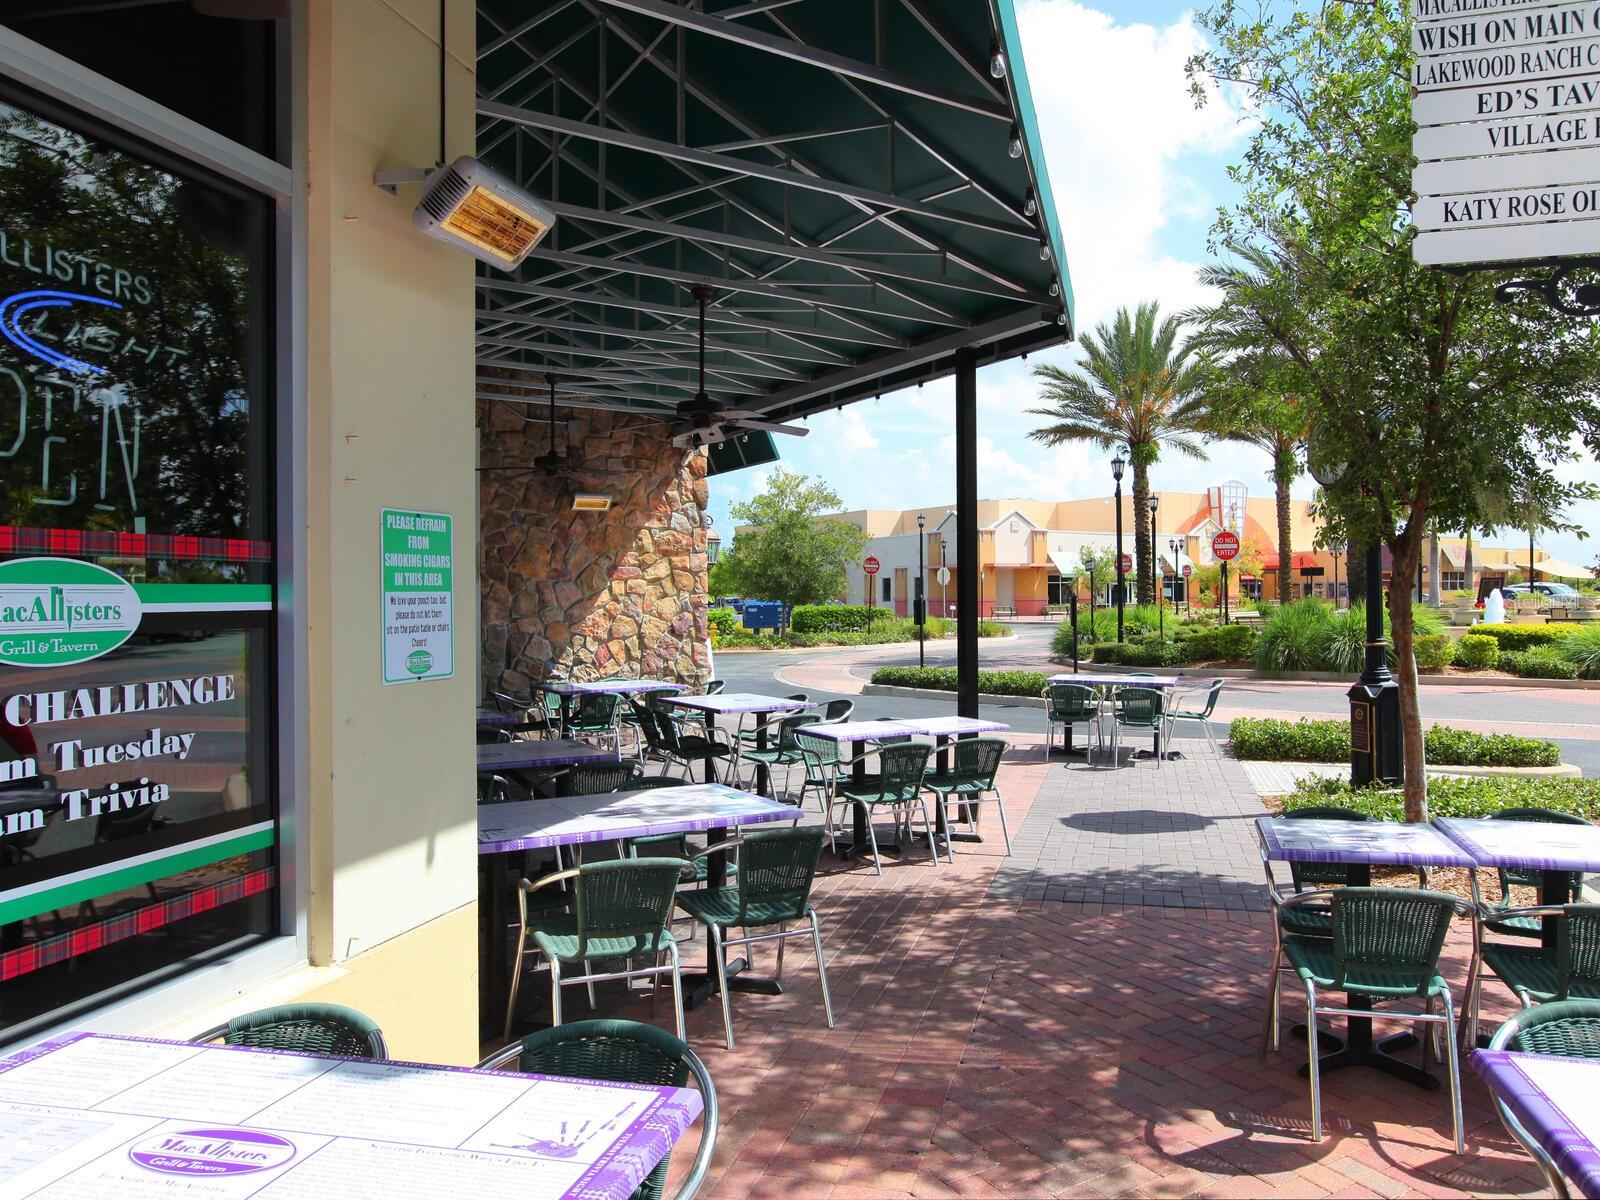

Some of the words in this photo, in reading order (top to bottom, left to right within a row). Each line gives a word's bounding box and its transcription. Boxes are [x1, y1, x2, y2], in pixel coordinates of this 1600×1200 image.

[1418, 22, 1477, 51] WISH
[1484, 18, 1516, 44] ON
[1524, 9, 1585, 39] MAIN
[1416, 54, 1516, 86] LAKEWOOD
[1520, 46, 1582, 74] RANCH
[1477, 88, 1538, 114] ED'S
[1547, 81, 1600, 106] TAV
[1487, 118, 1587, 148] VILLAGE
[1443, 197, 1502, 222] KATY
[1508, 192, 1565, 217] ROSE
[1572, 189, 1600, 212] OI
[387, 515, 414, 530] PLEASE
[416, 518, 446, 532] REFRAIN
[408, 536, 429, 549] FROM
[385, 553, 422, 567] SMOKING
[423, 555, 450, 568] CIGARS
[394, 572, 403, 585] IN
[405, 572, 422, 586] THIS
[424, 573, 442, 586] AREA
[0, 586, 121, 632] acAllisters
[391, 597, 396, 605] We
[408, 598, 417, 606] your
[396, 610, 409, 620] please
[410, 610, 415, 619] do
[431, 610, 442, 618] them
[409, 625, 420, 635] patio
[421, 624, 431, 633] table
[437, 624, 450, 632] chairs
[0, 640, 35, 656] Grill
[38, 642, 49, 653] &
[50, 638, 98, 653] Tavern
[5, 674, 235, 727] CHALLENGE
[54, 728, 195, 772] Tuesday
[0, 808, 46, 838] m
[61, 777, 169, 822] Trivia
[160, 1138, 270, 1160] MacAllisters
[149, 1158, 177, 1168] Grill
[188, 1161, 227, 1172] Tavern
